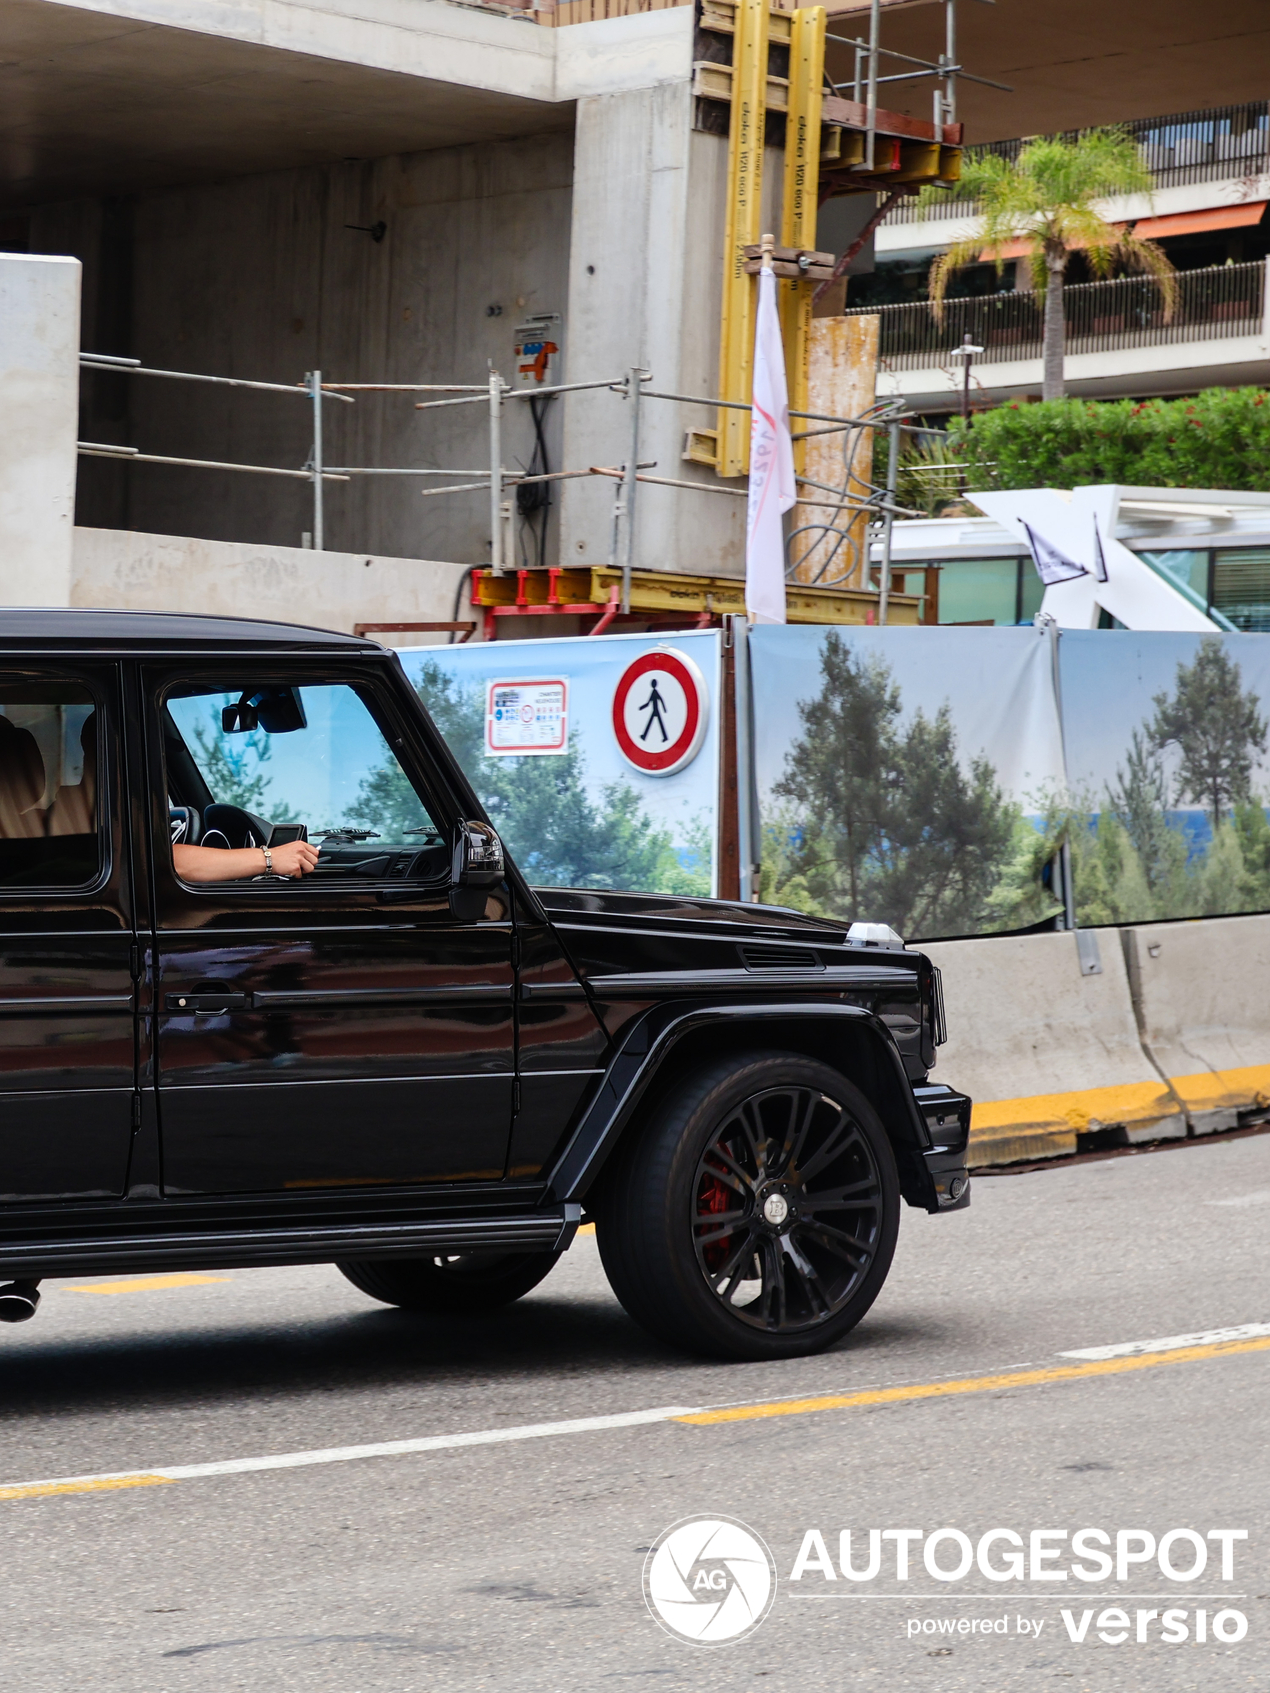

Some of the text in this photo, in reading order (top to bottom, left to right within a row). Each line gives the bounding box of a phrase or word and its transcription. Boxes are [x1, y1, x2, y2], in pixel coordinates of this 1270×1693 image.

[740, 101, 751, 145] doka
[797, 115, 807, 158] doka
[770, 1200, 784, 1217] B
